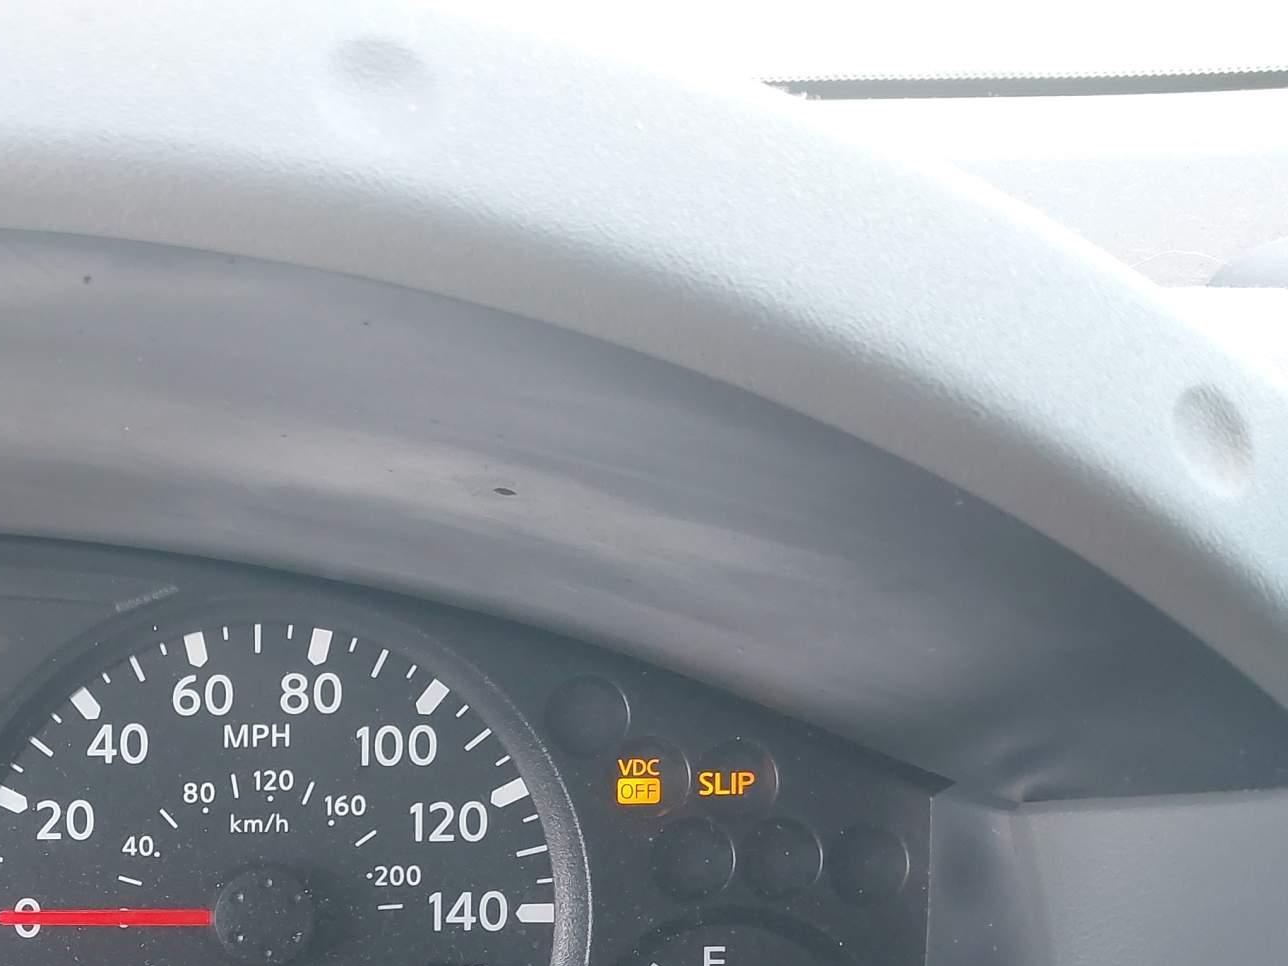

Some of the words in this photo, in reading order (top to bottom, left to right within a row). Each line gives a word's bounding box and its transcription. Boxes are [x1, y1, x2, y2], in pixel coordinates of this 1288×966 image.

[172, 674, 234, 716] 60
[279, 672, 343, 715] 80
[86, 723, 149, 765] 40
[223, 723, 290, 749] MPH
[356, 724, 437, 767] 100
[253, 769, 294, 791] 120
[617, 758, 660, 777] VDC
[183, 782, 216, 804] 80
[620, 783, 657, 800] OFF
[699, 771, 755, 796] SLIP
[324, 794, 367, 816] 160
[36, 799, 95, 841] 20
[230, 813, 289, 833] km/h
[409, 800, 488, 842] 120
[374, 865, 422, 886] 200
[428, 891, 508, 932] 140
